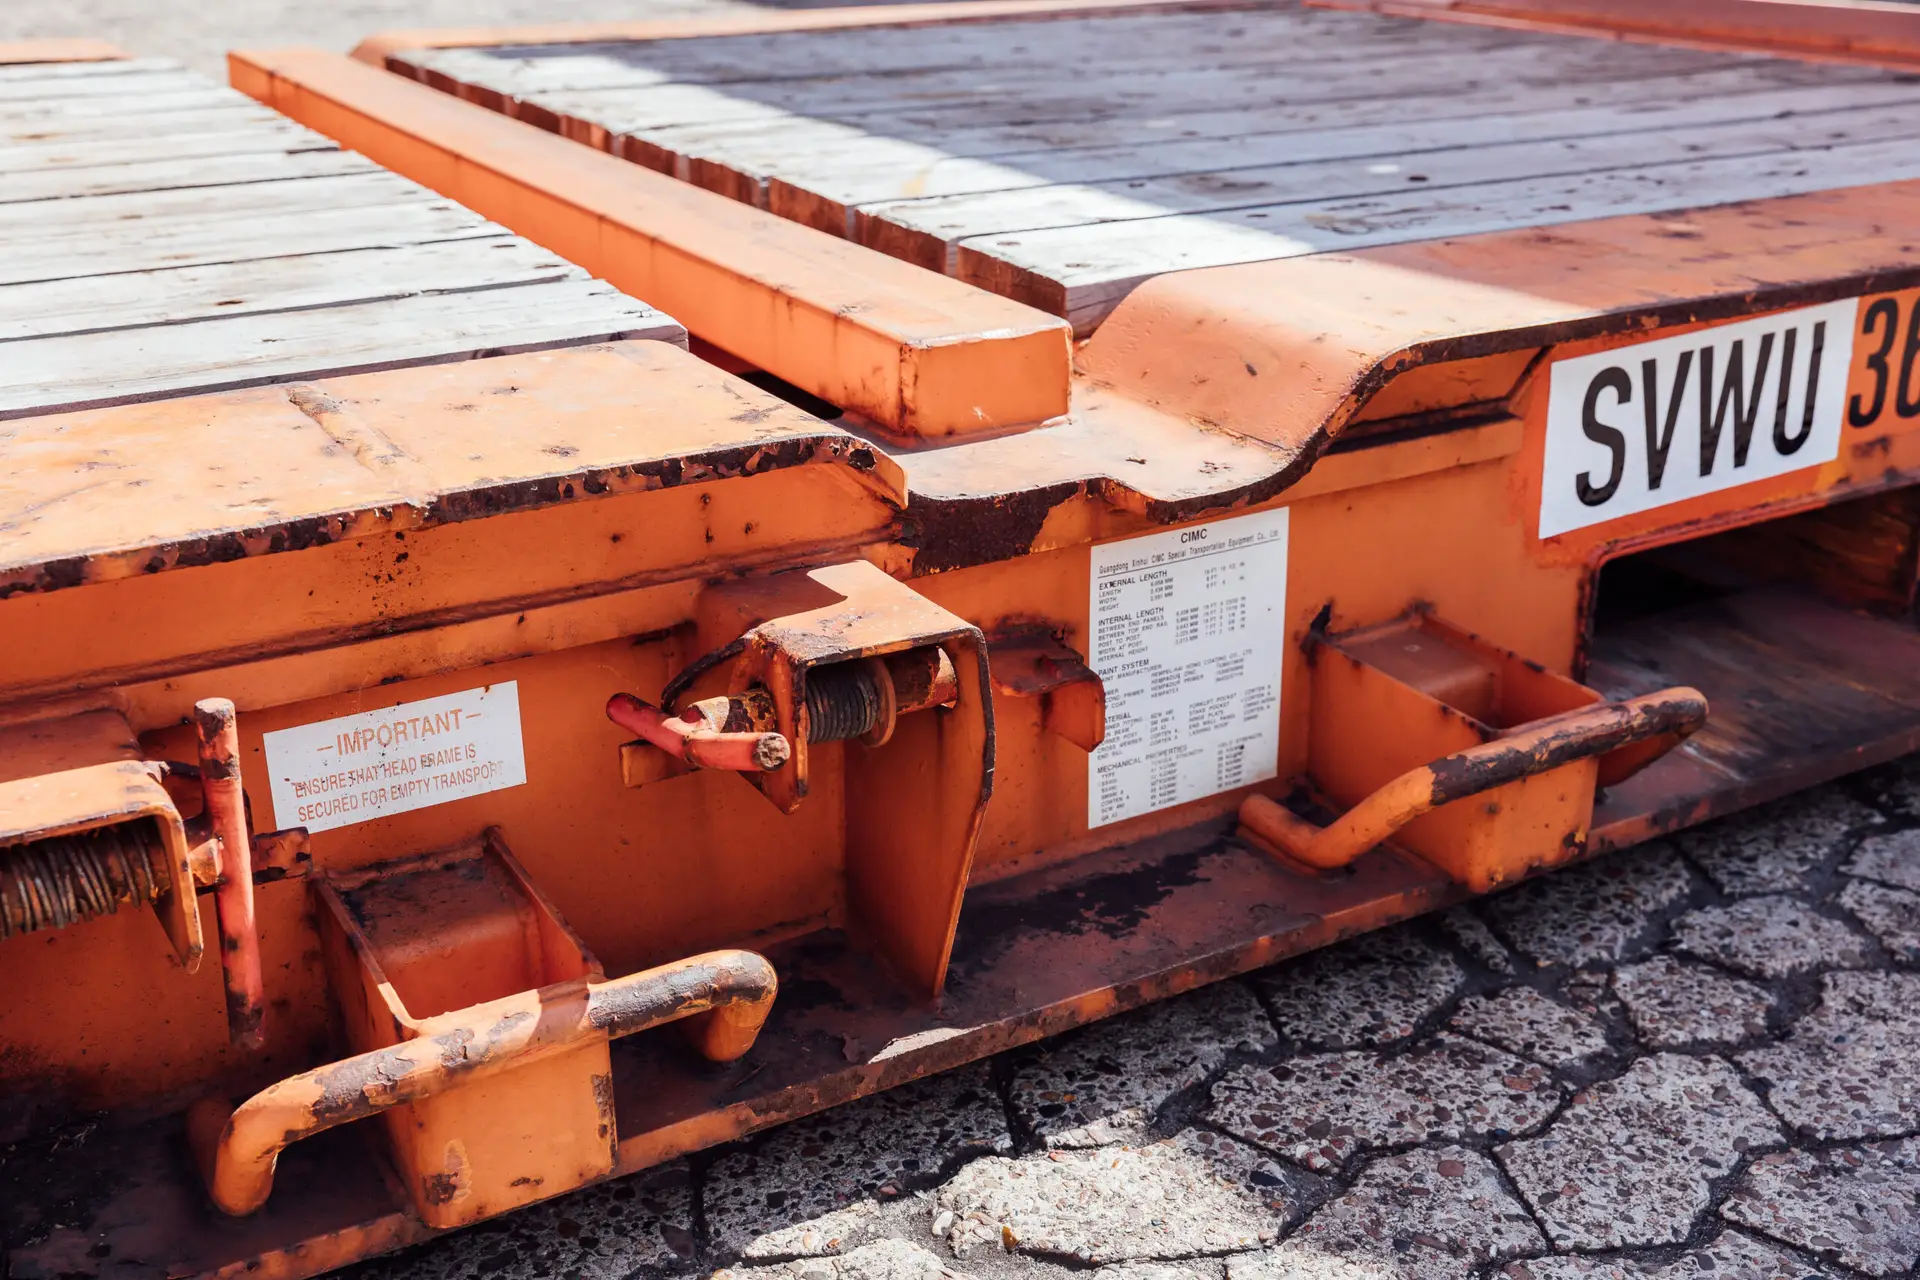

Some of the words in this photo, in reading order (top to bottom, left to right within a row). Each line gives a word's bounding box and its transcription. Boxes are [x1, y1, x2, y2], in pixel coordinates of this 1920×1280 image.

[1576, 321, 1826, 507] SVWU
[1180, 528, 1207, 543] CIMC
[1098, 560, 1128, 576] Guangdong
[1151, 552, 1164, 563] CIMC
[1168, 548, 1186, 561] Special
[1189, 540, 1225, 556] Transportation
[1228, 534, 1253, 548] Equipment
[1099, 576, 1135, 590] EXTERNAL
[1139, 569, 1167, 582] LENGTH
[1099, 588, 1121, 598] LENGTH
[1099, 596, 1116, 605] WIDTH
[1098, 603, 1118, 612] HEIGHT
[1098, 612, 1131, 626] INTERNAL
[1136, 605, 1163, 618] LENGTH
[1098, 623, 1124, 633] BETWEEN
[1128, 619, 1139, 627] END
[1143, 614, 1163, 623] PANELS
[1098, 630, 1124, 641] BETWEEN
[1142, 623, 1152, 631] END
[1098, 639, 1111, 648] POST
[1125, 633, 1139, 641] POST
[1098, 646, 1115, 655] WIDTH
[1128, 640, 1142, 648] POST
[1098, 651, 1124, 662] INTERNAL
[1128, 646, 1147, 655] HEIGHT
[1098, 666, 1117, 676] PAINT
[1121, 658, 1148, 670] SYSTEM
[1117, 663, 1161, 678] MANUFACTURER
[1111, 700, 1125, 708] COAT
[1104, 711, 1130, 723] ATERIAL
[1097, 756, 1141, 774] MECHANICAL
[1145, 744, 1187, 761] PROPERTIES
[295, 772, 347, 799] ENSURE
[349, 765, 379, 787] THAT
[384, 757, 417, 780] HEAD
[421, 747, 463, 770] FRAME
[465, 743, 476, 760] IS
[298, 794, 359, 823] SECURED
[362, 788, 388, 808] FOR
[391, 778, 431, 801] EMPTY
[433, 761, 504, 791] TRANSPORT
